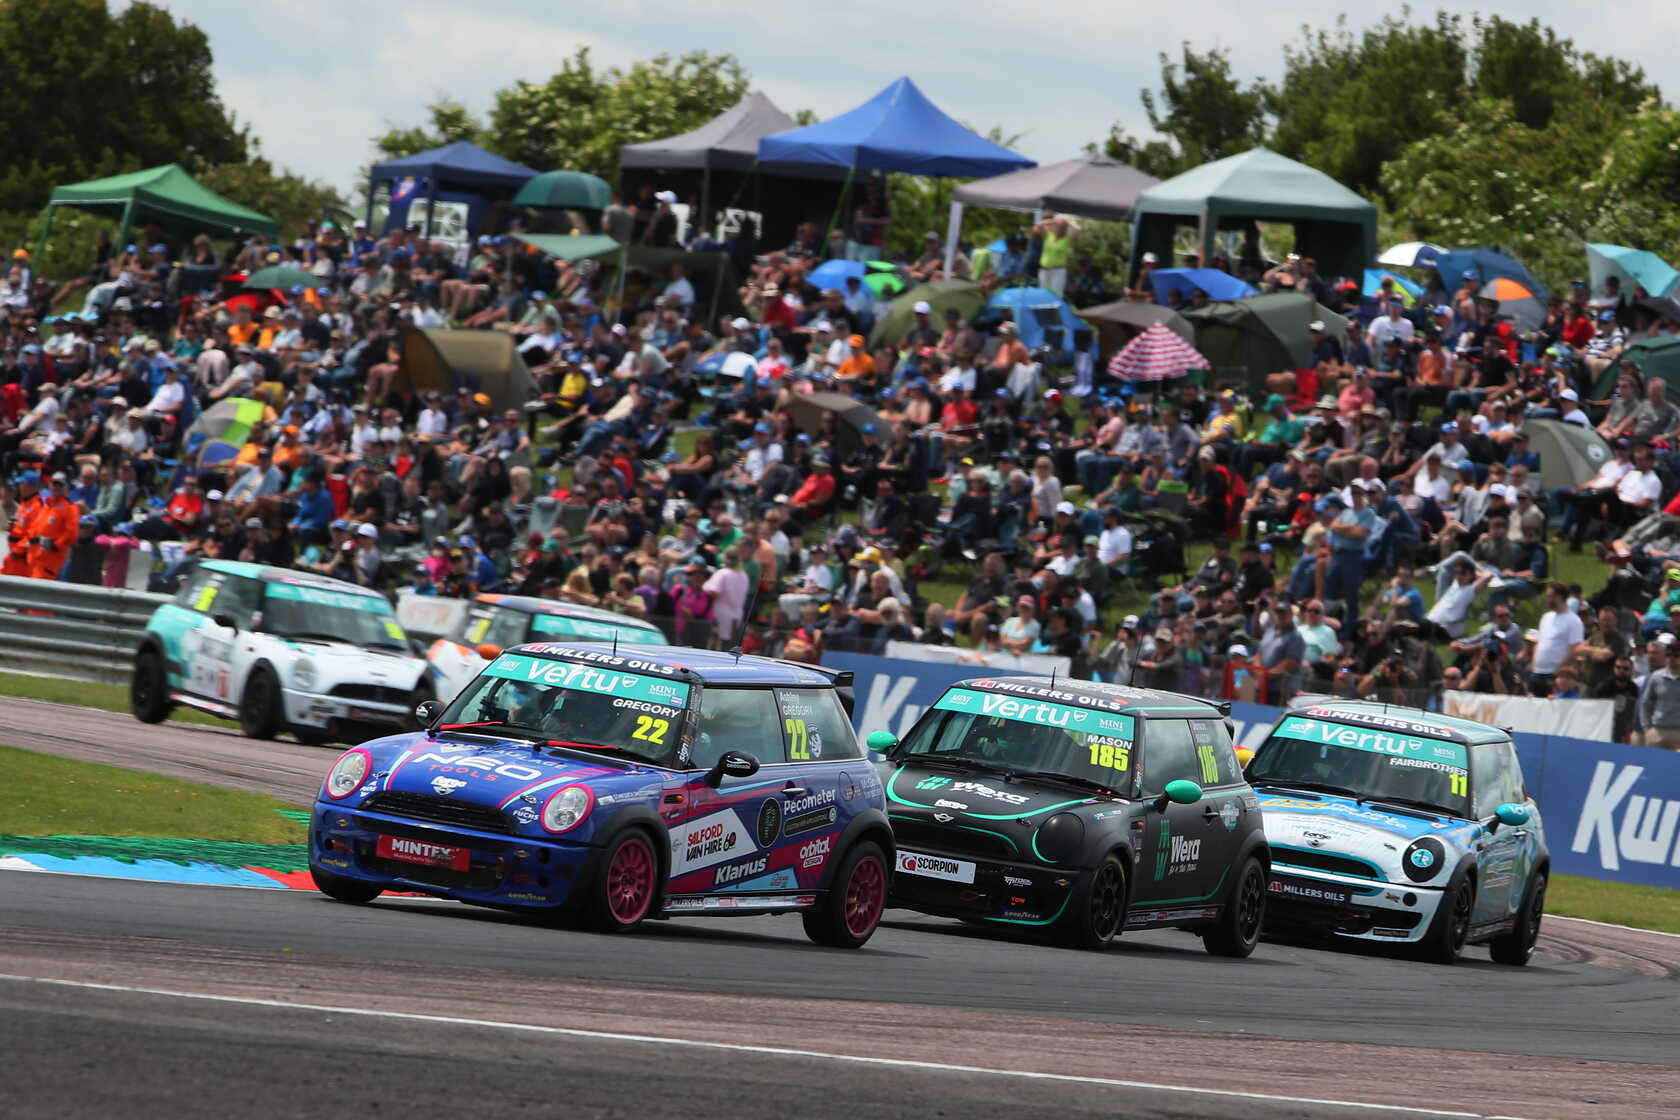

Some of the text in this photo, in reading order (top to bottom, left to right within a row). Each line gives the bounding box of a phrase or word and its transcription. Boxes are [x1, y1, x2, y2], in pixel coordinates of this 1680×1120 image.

[543, 645, 674, 675] MILLERS OILS
[527, 660, 619, 692] Vertu
[612, 698, 681, 718] GREGORY
[995, 682, 1073, 700] MILLERS
[1078, 695, 1121, 710] OILS
[983, 694, 1071, 726] Vertu
[631, 715, 669, 745] 22
[1330, 710, 1407, 729] MILLERS
[1411, 723, 1452, 738] OILS
[785, 719, 810, 760] 22
[1087, 734, 1133, 750] MASON
[1320, 724, 1407, 754] Vertu
[412, 753, 542, 781] NEO
[1088, 743, 1129, 772] 185
[1389, 757, 1468, 777] FAIRBROTHER
[429, 764, 498, 782] TOOLS
[1449, 773, 1467, 798] 11
[513, 809, 539, 820] FUCHS
[784, 789, 836, 816] Pecometer
[1571, 760, 1680, 871] Kw
[687, 823, 723, 847] SALFORD
[686, 844, 703, 861] VAN
[703, 837, 722, 857] HIRE
[1170, 835, 1201, 863] Wera
[714, 858, 767, 885] Klarius
[917, 857, 959, 875] SCORPION
[1283, 884, 1345, 902] MILLERS OILS
